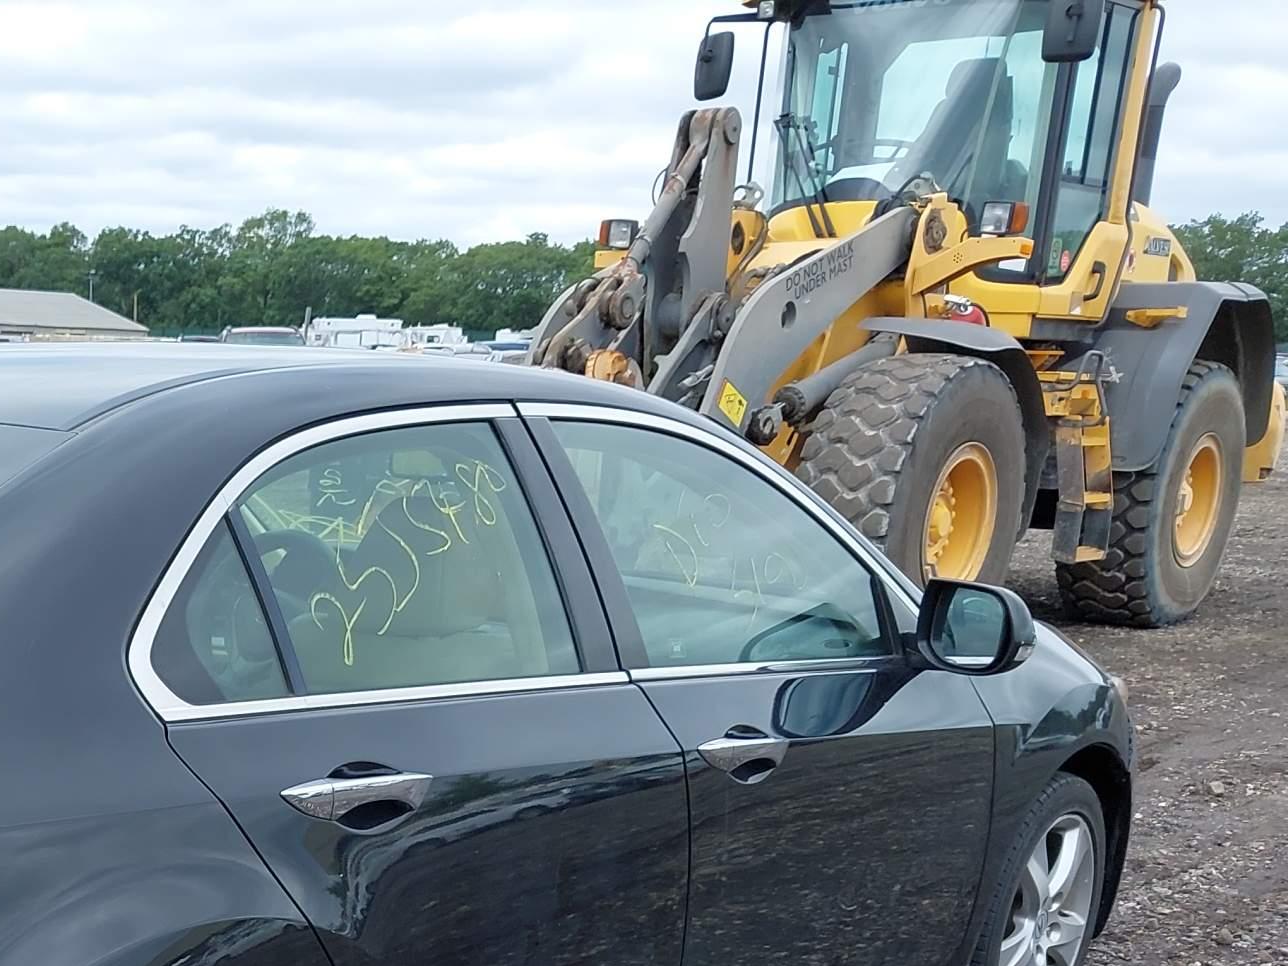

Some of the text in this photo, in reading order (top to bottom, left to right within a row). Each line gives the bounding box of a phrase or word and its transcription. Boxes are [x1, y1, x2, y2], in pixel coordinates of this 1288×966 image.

[785, 240, 854, 291] DO NOT WALK
[795, 255, 853, 299] UNDER MAST
